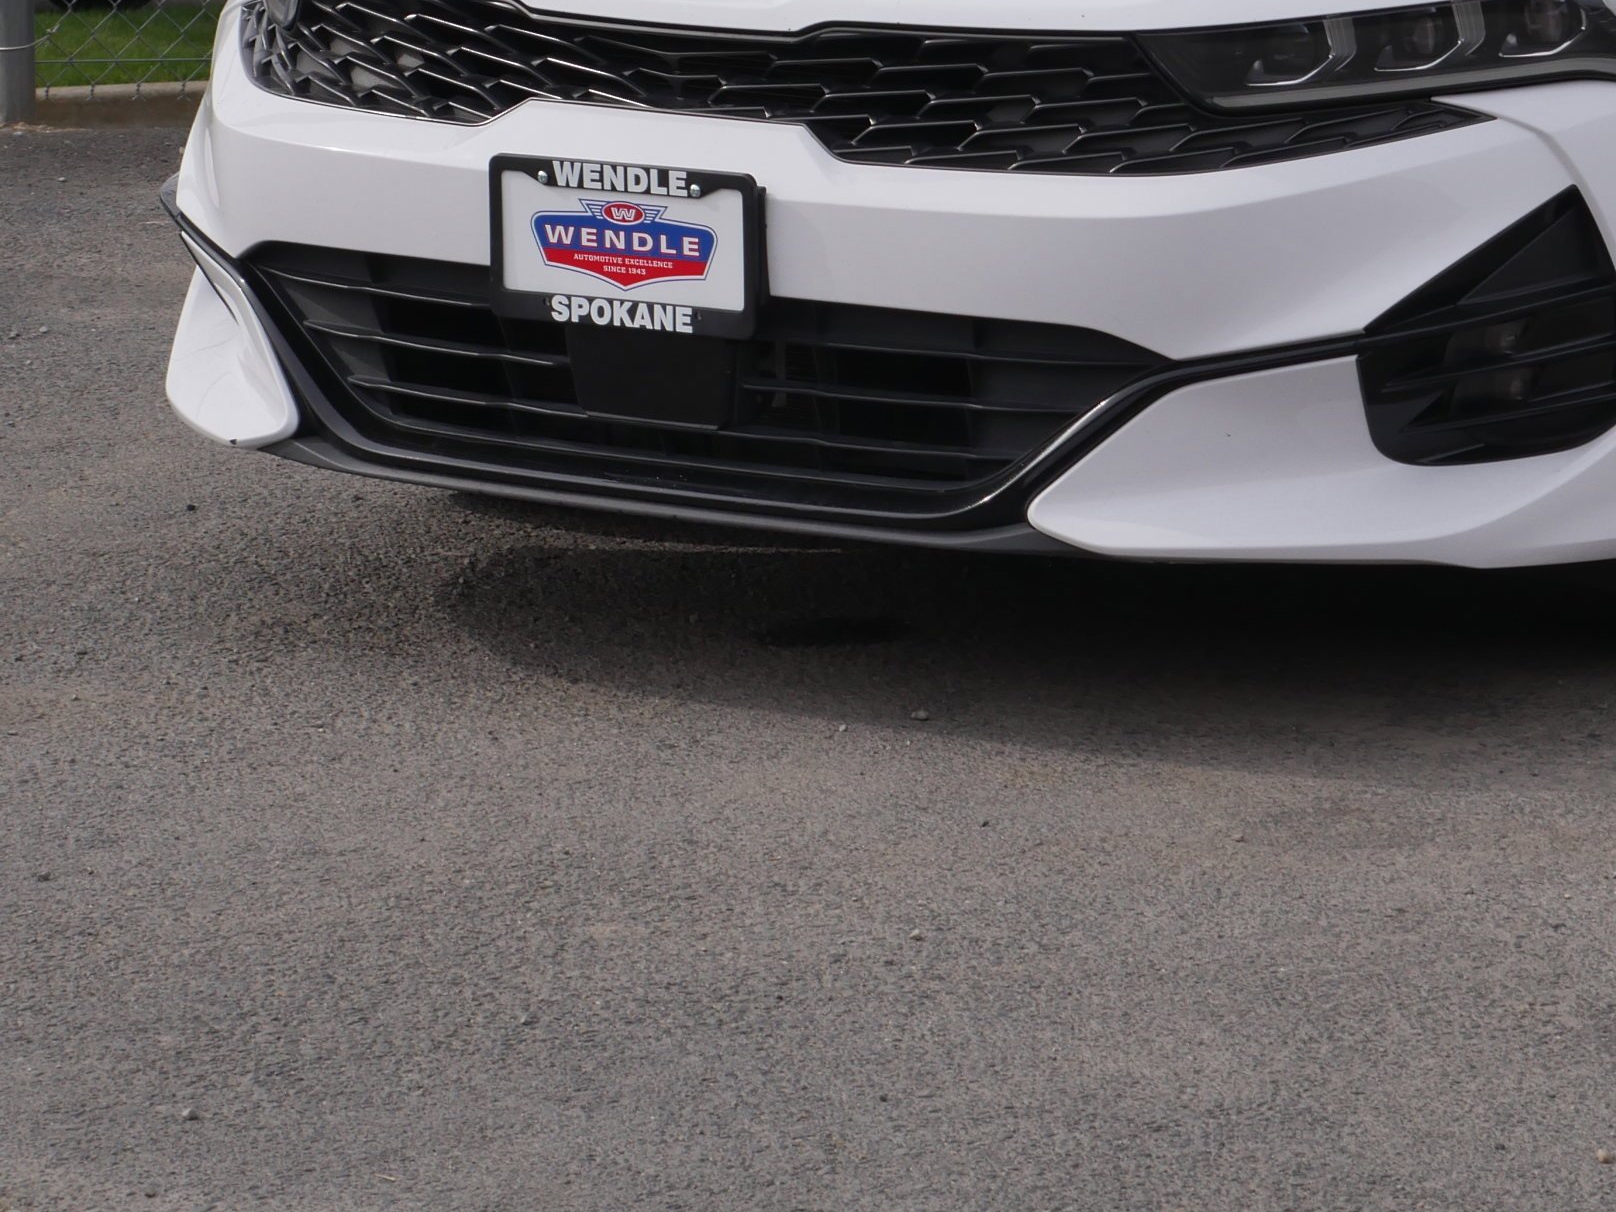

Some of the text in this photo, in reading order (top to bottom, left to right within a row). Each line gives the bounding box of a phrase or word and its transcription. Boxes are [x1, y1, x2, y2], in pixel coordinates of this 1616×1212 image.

[552, 160, 689, 197] WENDLE
[544, 224, 700, 256] WENDLE
[573, 253, 673, 269] AUTOMOTIVE EXCELLENCE
[603, 265, 647, 275] SINCE 1943
[551, 295, 693, 334] SPOKANE
